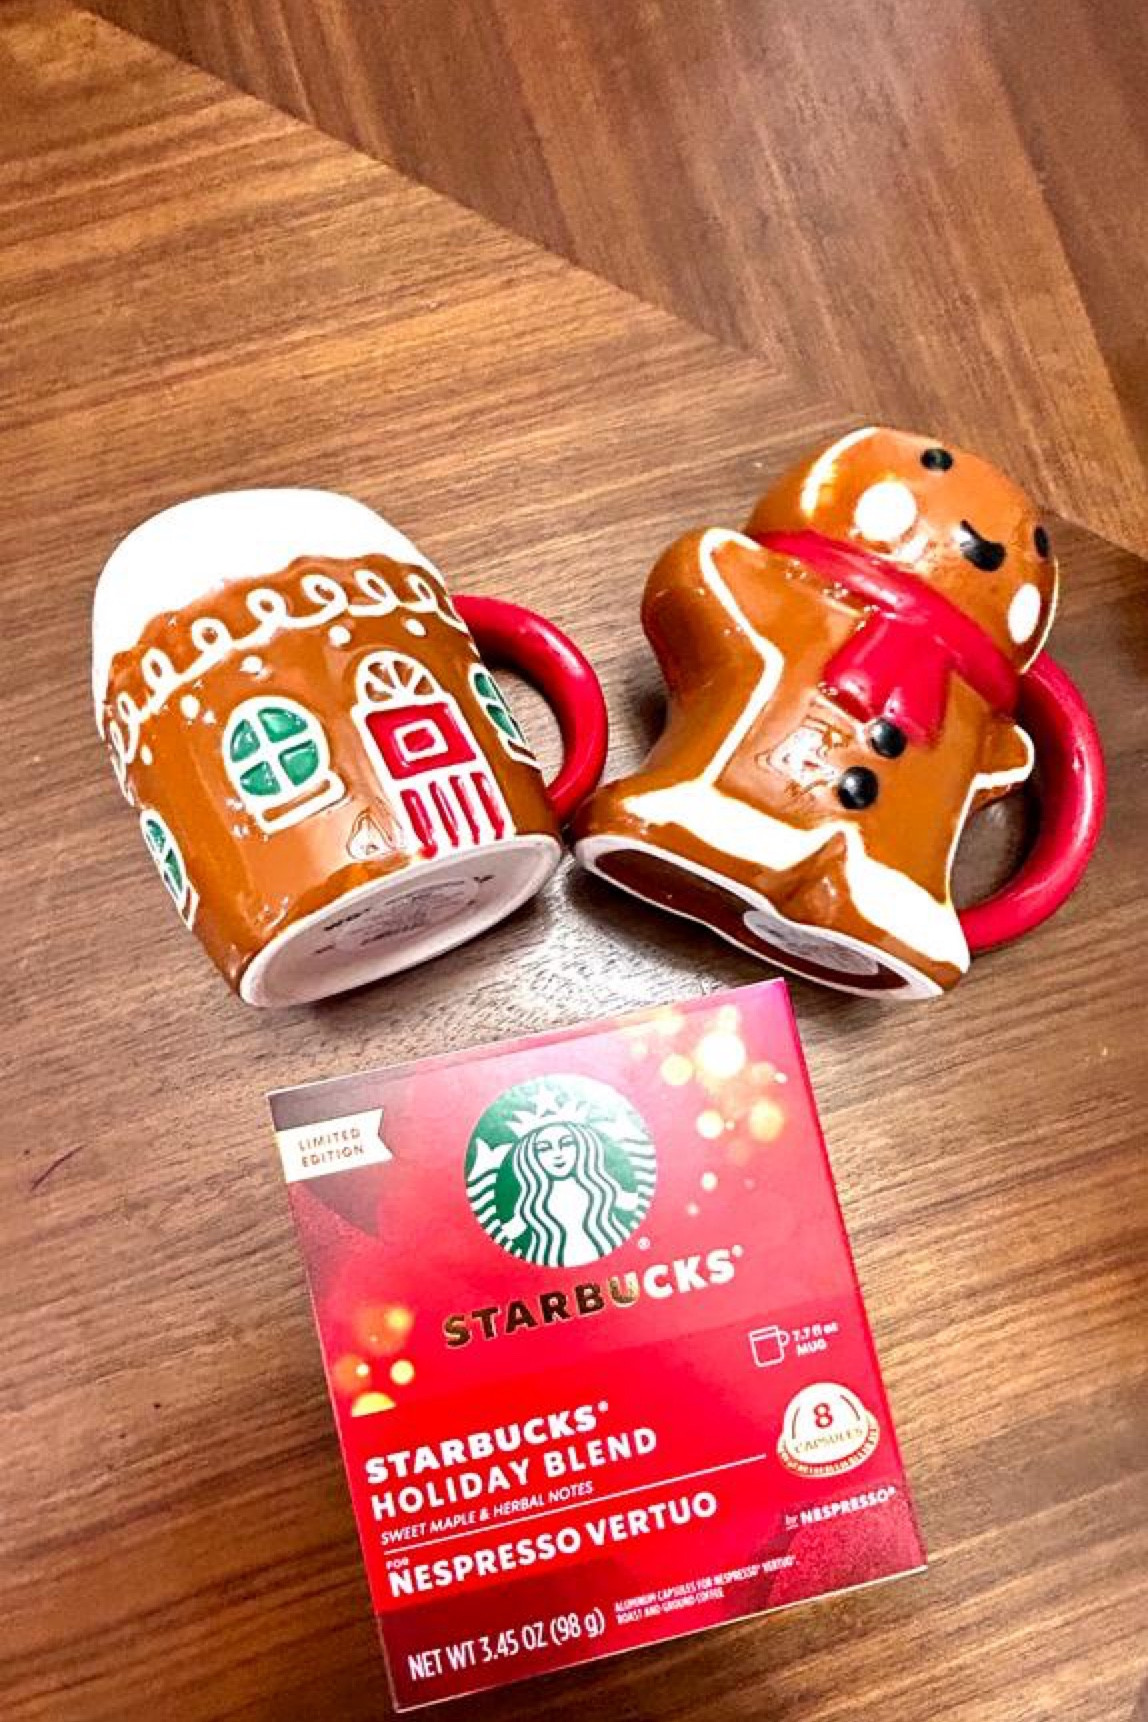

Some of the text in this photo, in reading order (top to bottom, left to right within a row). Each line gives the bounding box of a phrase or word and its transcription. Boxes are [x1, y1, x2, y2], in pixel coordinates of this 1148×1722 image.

[298, 1128, 361, 1151] LIMITED
[302, 1145, 364, 1167] EDITION
[442, 1249, 735, 1349] STARBUCKS
[797, 1338, 827, 1357] MUG
[813, 1402, 833, 1429] 8
[365, 1404, 598, 1484] STARBUCKS
[795, 1427, 863, 1453] CAPSULES
[371, 1427, 658, 1521] HOLIDAY BLEND
[380, 1480, 595, 1546] SWEET MAPLE & HERBAL NOTES
[386, 1557, 409, 1570] FOR
[387, 1491, 717, 1598] NESPRESSO VERTUO
[407, 1607, 606, 1682] NET WT 3.45 OZ (98 g)
